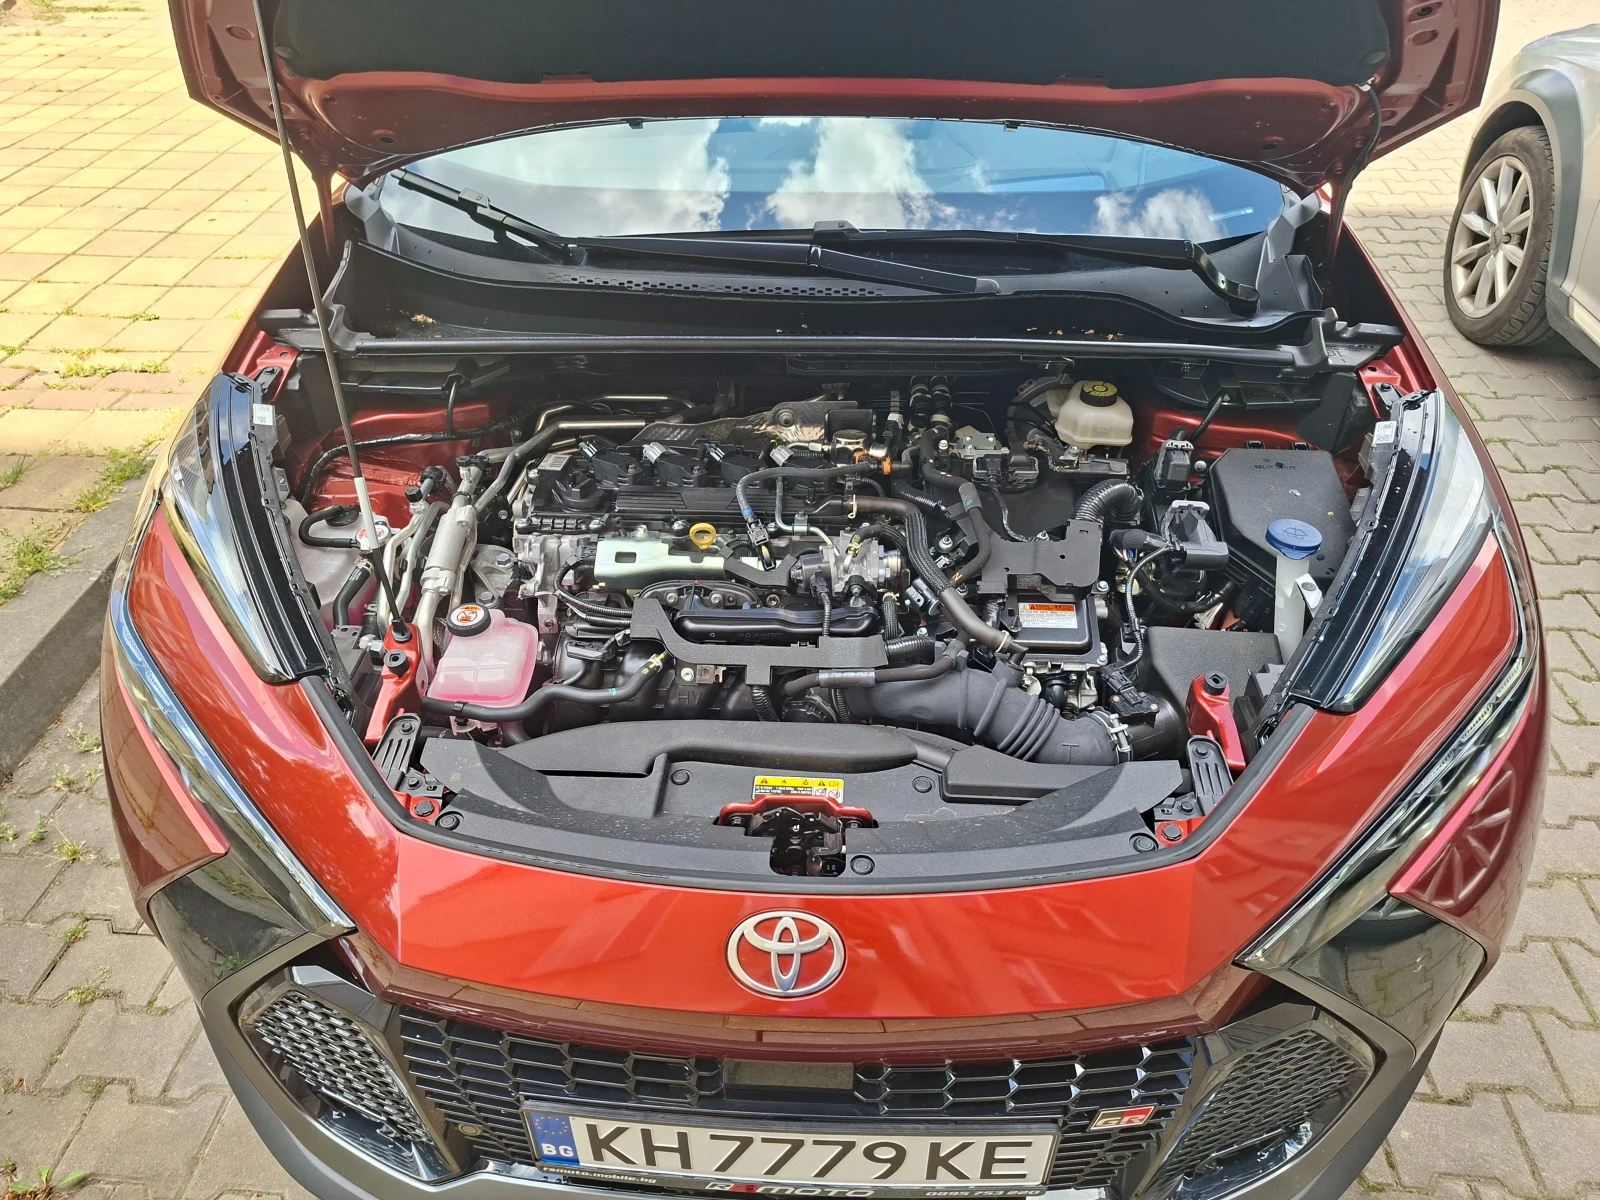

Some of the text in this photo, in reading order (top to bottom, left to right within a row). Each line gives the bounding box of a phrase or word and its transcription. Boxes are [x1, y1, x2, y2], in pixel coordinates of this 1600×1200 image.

[1095, 1114, 1146, 1127] GR
[542, 1143, 574, 1158] BG
[586, 1123, 1033, 1181] KH 7779 KE
[542, 1166, 657, 1184] rsmoto.mobile.bg
